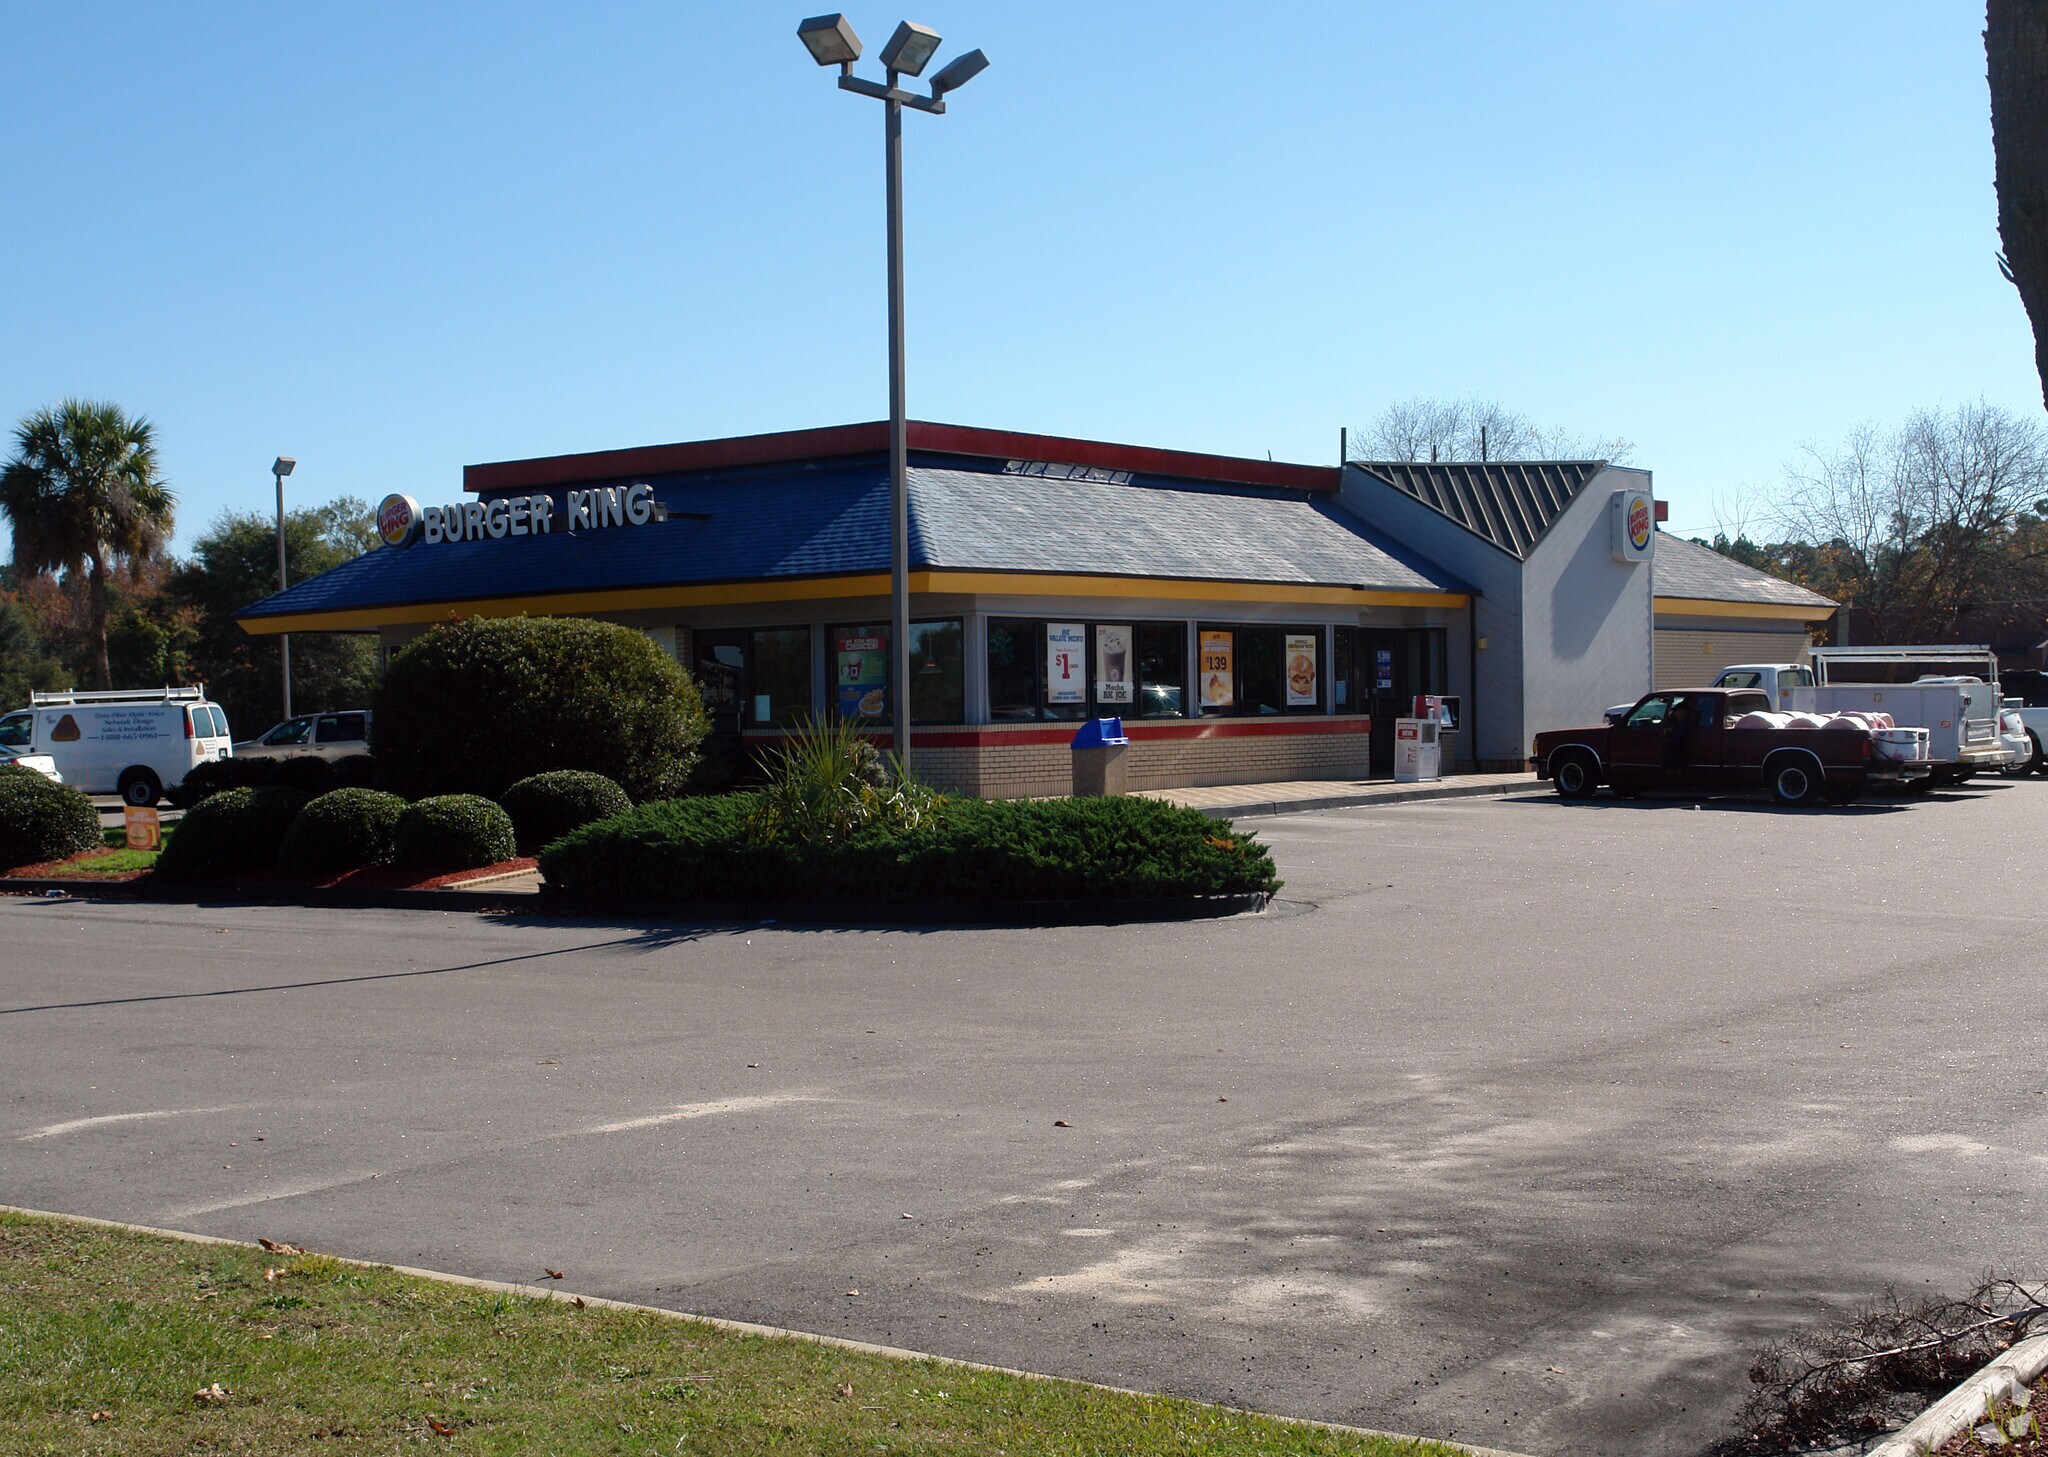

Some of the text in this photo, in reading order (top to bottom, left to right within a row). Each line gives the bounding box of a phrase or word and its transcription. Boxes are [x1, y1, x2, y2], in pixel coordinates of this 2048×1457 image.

[379, 501, 407, 527] BURGER
[381, 511, 409, 539] KING
[424, 484, 654, 544] BURGER KING
[1630, 506, 1648, 525] BURGER
[1631, 517, 1649, 540] KING
[1056, 653, 1070, 679] $1
[1115, 691, 1127, 701] JOE
[133, 718, 154, 726] Design
